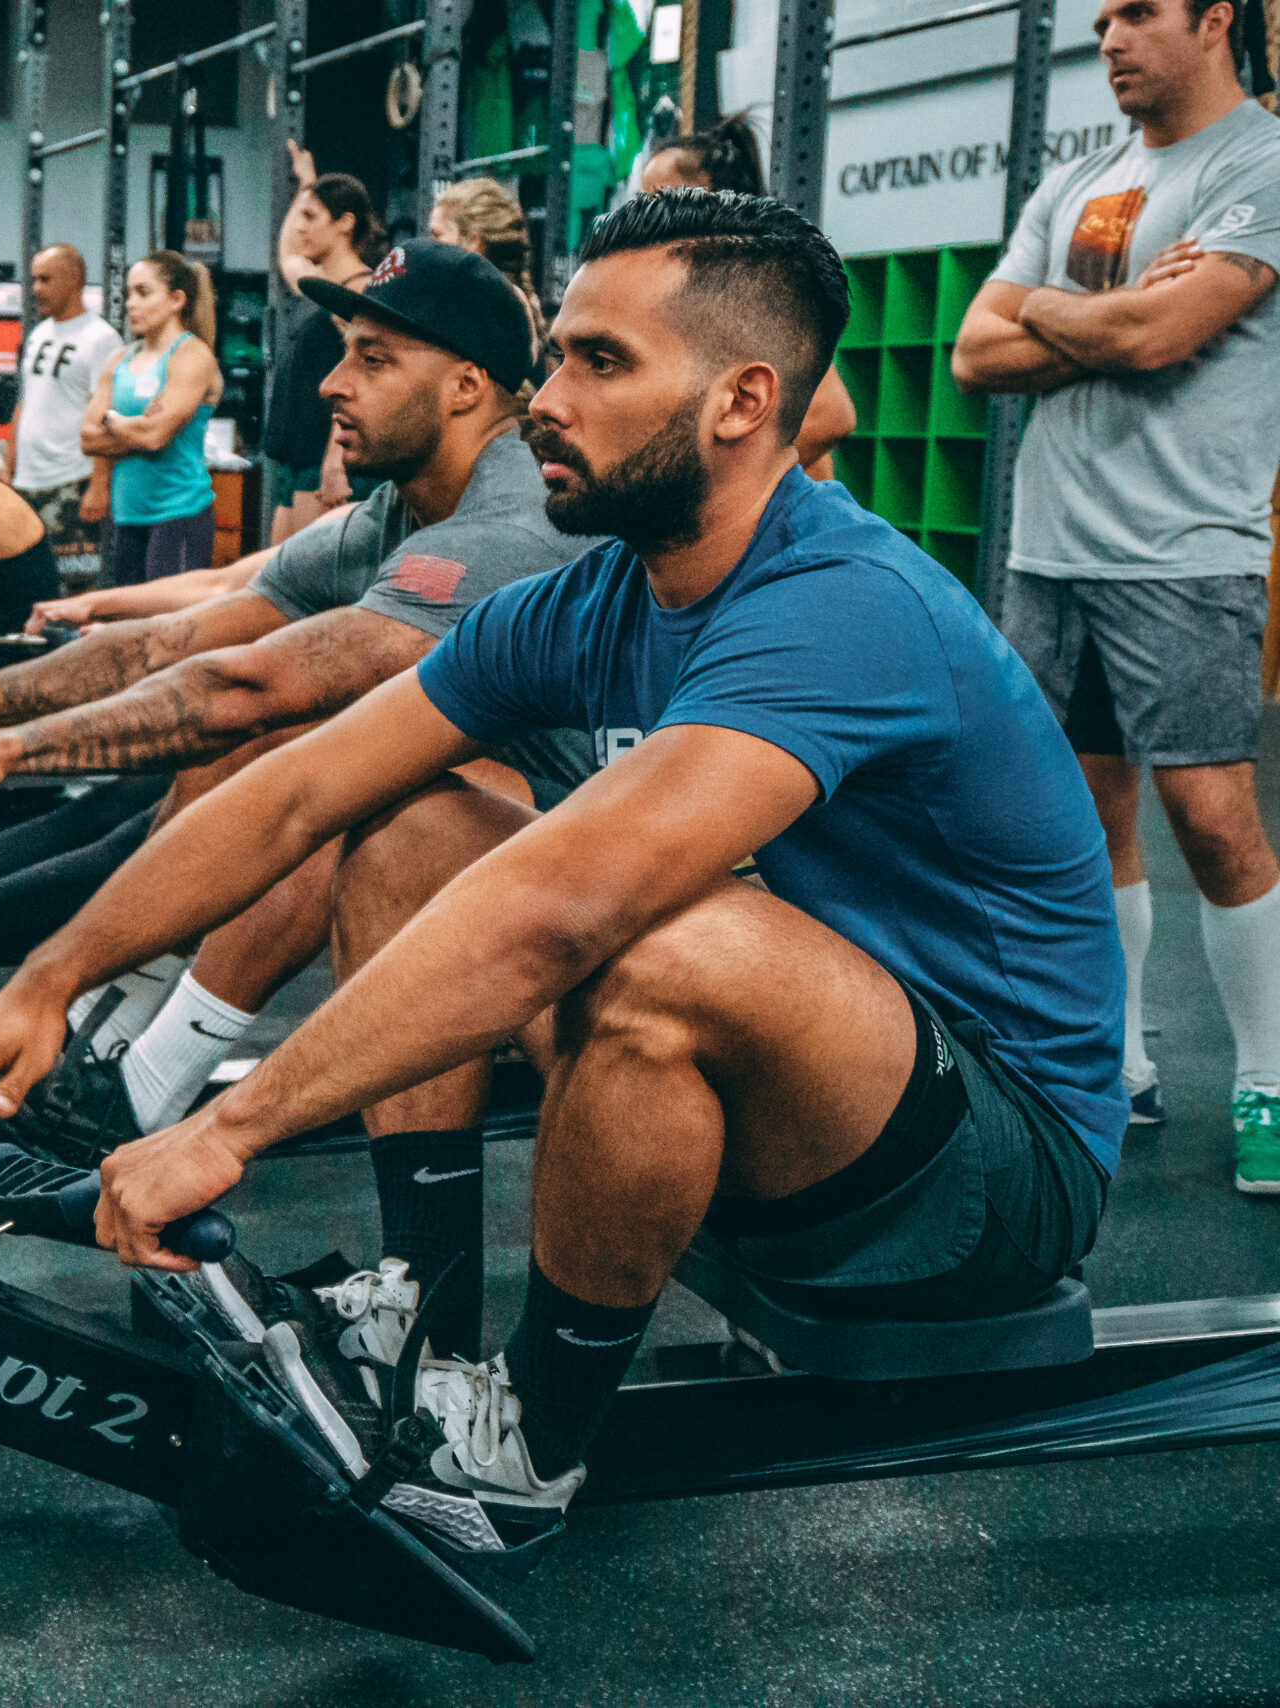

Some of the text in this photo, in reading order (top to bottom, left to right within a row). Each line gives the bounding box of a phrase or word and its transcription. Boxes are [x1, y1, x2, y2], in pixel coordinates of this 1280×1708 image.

[839, 151, 942, 197] CAPTAIN
[950, 142, 988, 180] OF
[90, 1392, 150, 1444] 2
